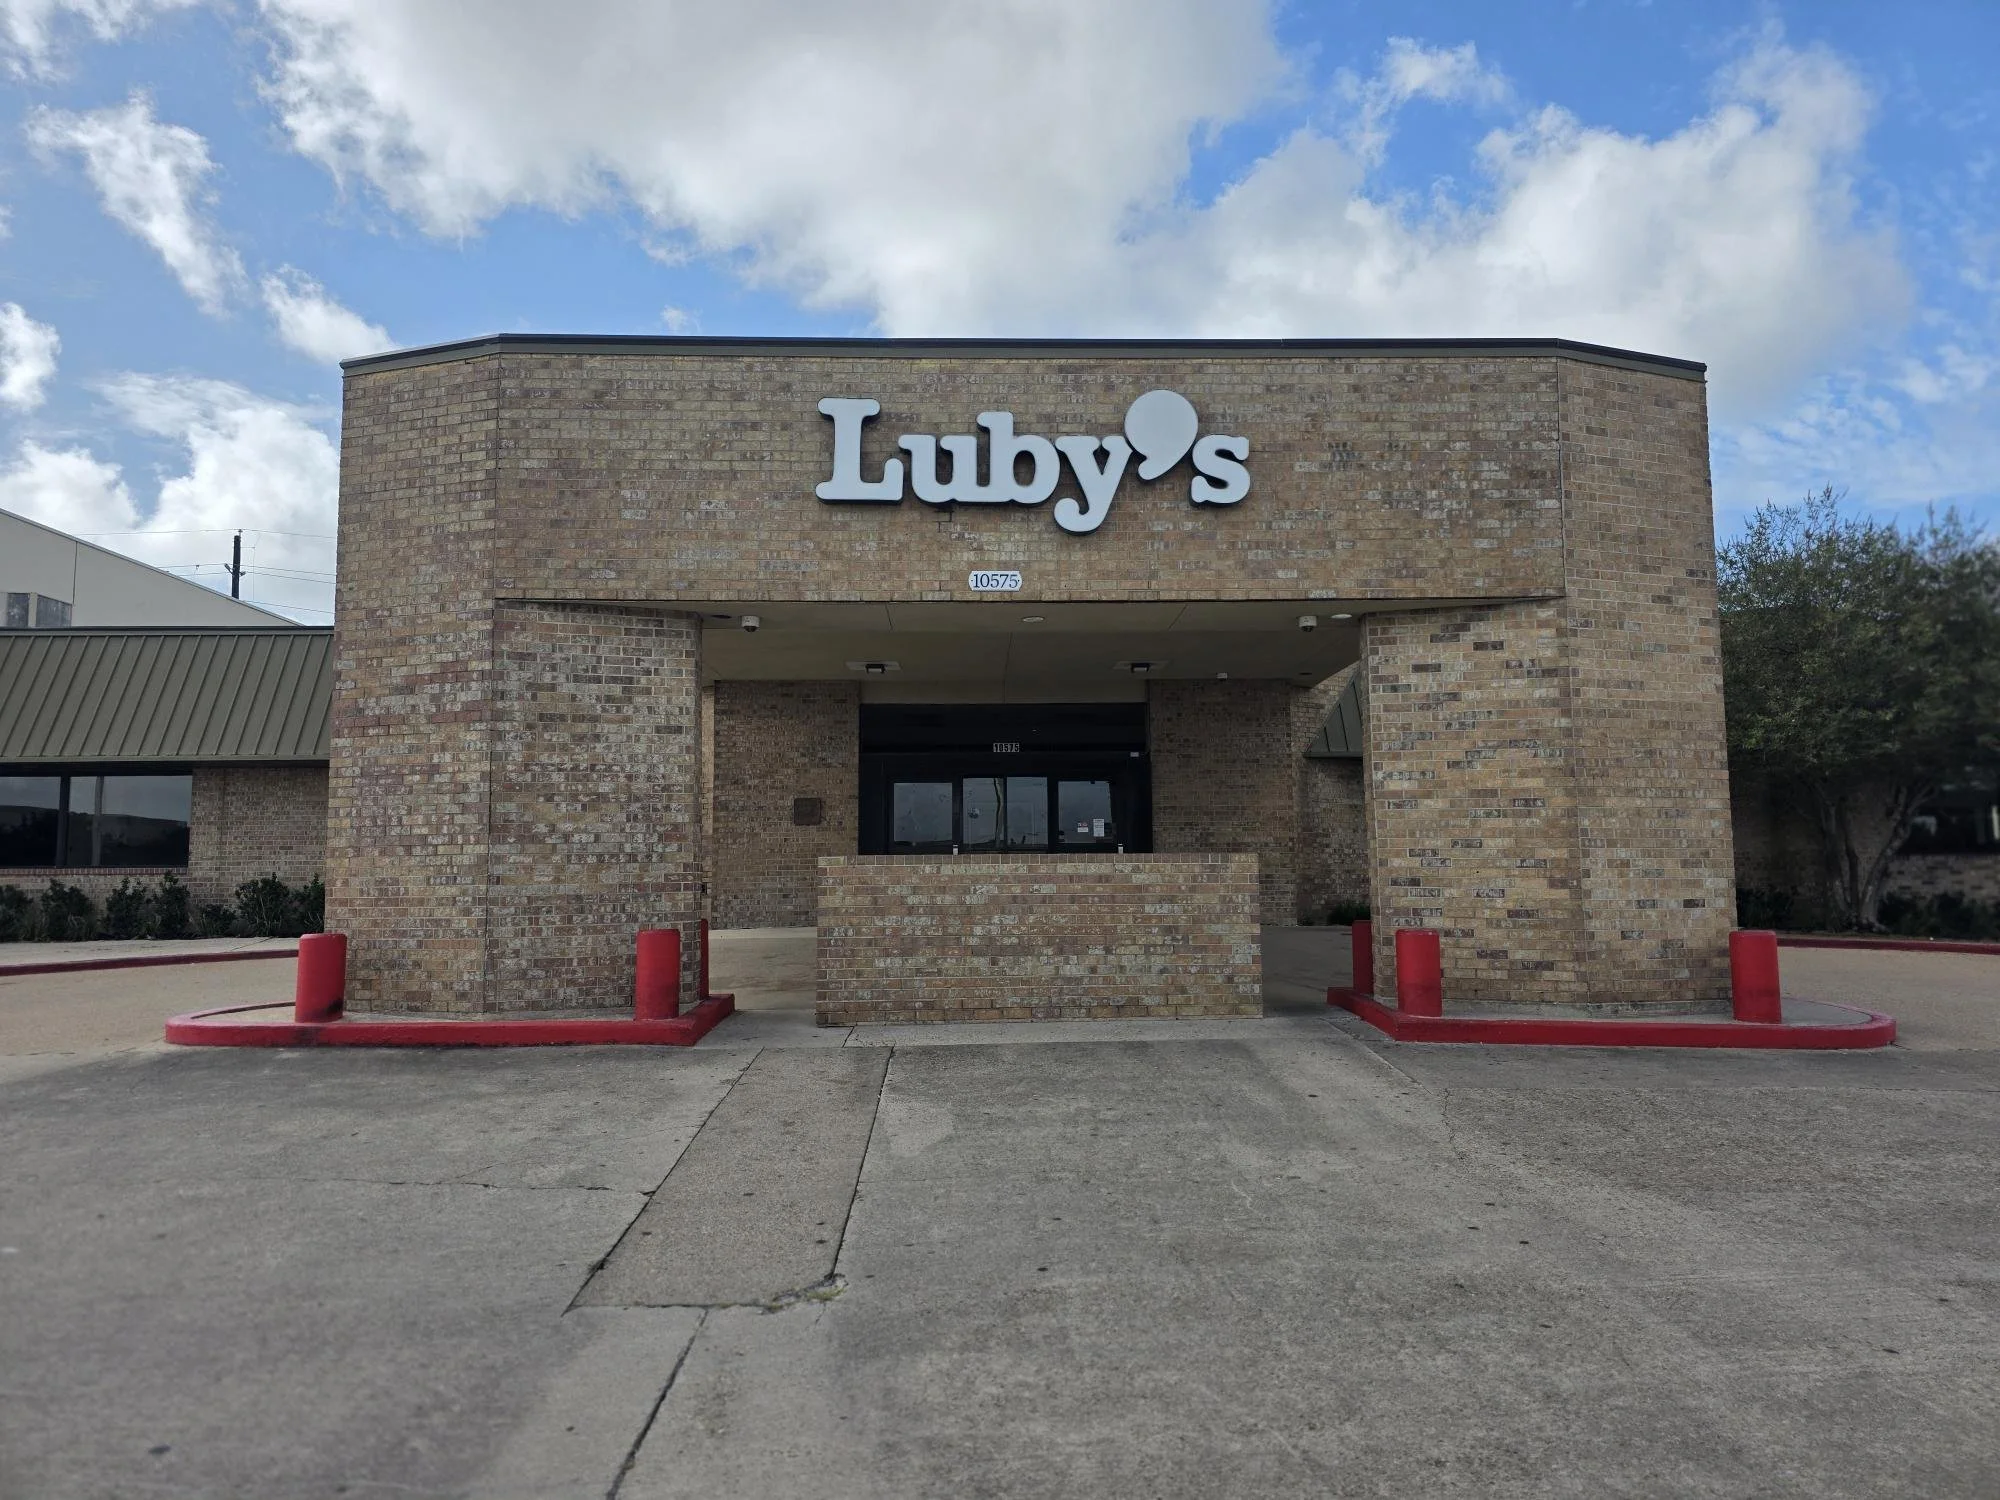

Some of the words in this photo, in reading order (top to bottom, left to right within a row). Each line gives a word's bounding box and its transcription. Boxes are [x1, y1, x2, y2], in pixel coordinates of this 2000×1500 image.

[815, 389, 1252, 534] Luby's
[973, 573, 1018, 588] 10575
[993, 743, 1020, 753] 10575
